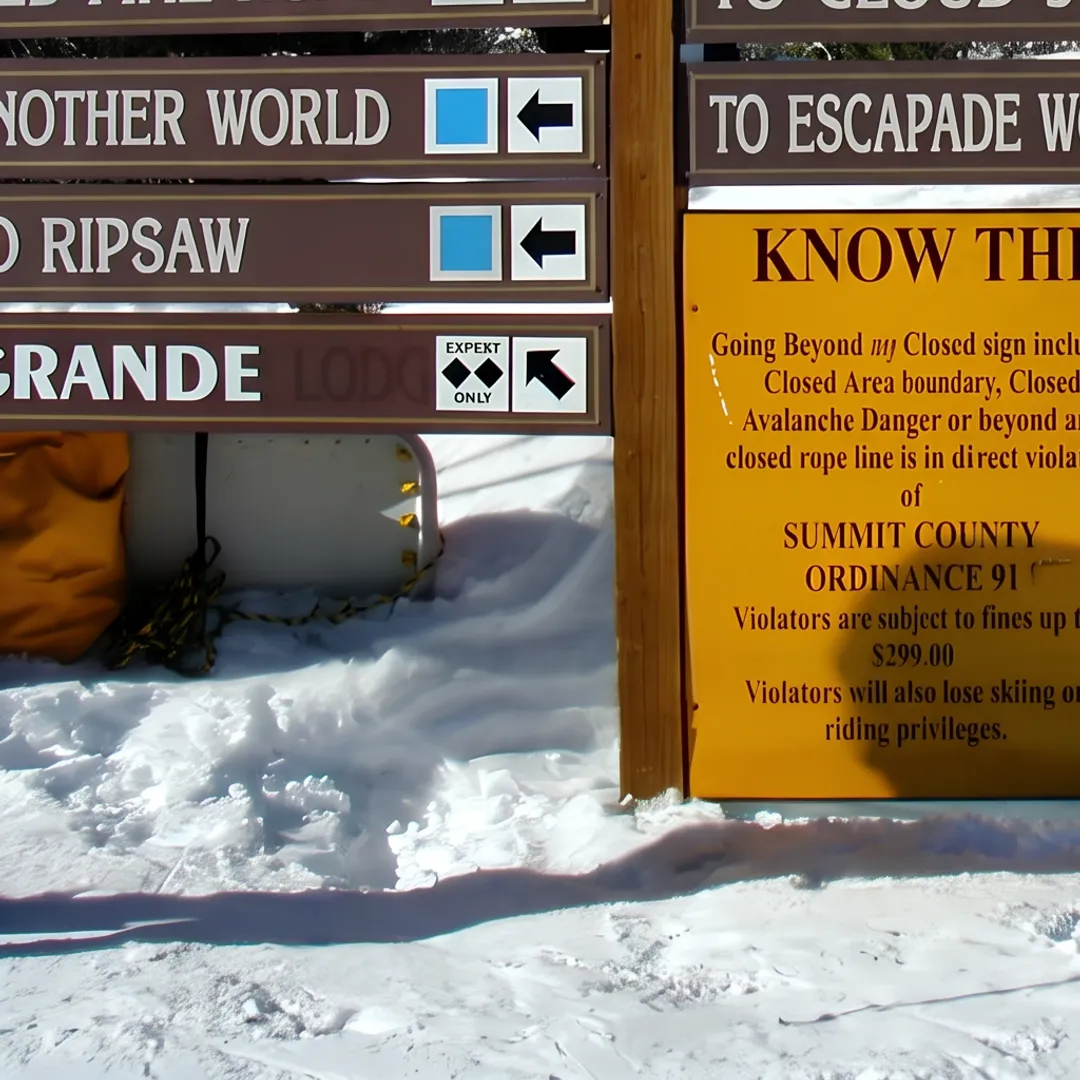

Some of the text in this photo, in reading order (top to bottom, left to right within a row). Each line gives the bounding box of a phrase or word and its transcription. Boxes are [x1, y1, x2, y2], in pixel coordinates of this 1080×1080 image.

[205, 87, 390, 147] WORLD
[708, 93, 769, 155] TO
[787, 92, 1022, 154] ESCAPADE
[41, 216, 250, 274] RIPSAW
[752, 227, 956, 283] KNOW
[711, 332, 776, 364] Going
[784, 332, 863, 364] Beyond
[903, 331, 976, 356] Closed
[983, 331, 1026, 363] sign
[0, 344, 261, 402] RANDE
[764, 369, 1080, 401] Closed Area boundary, Closed
[454, 391, 492, 404] ONLY
[742, 407, 854, 432] Avalanche
[861, 407, 942, 440] Danger
[948, 414, 973, 432] or
[979, 407, 1057, 439] beyond
[726, 444, 792, 469] closed
[800, 451, 847, 476] rope
[855, 444, 894, 469] line
[901, 444, 917, 469] is
[924, 444, 944, 469] in
[952, 444, 1018, 470] direct
[901, 482, 923, 507] of
[784, 521, 1040, 550] SUMMIT COUNTY
[805, 563, 983, 593] ORDINANCE
[734, 606, 831, 630] Violators
[838, 612, 873, 630] are
[878, 604, 948, 636] subject
[954, 608, 975, 630] to
[982, 604, 1033, 630] fines
[1039, 611, 1067, 637] up
[872, 643, 954, 668] $299.00
[745, 680, 842, 704] Violators
[849, 679, 888, 704] will
[894, 680, 937, 704] also
[943, 679, 984, 704] lose
[990, 679, 1056, 710] skiing
[825, 715, 1007, 748] riding privileges.
